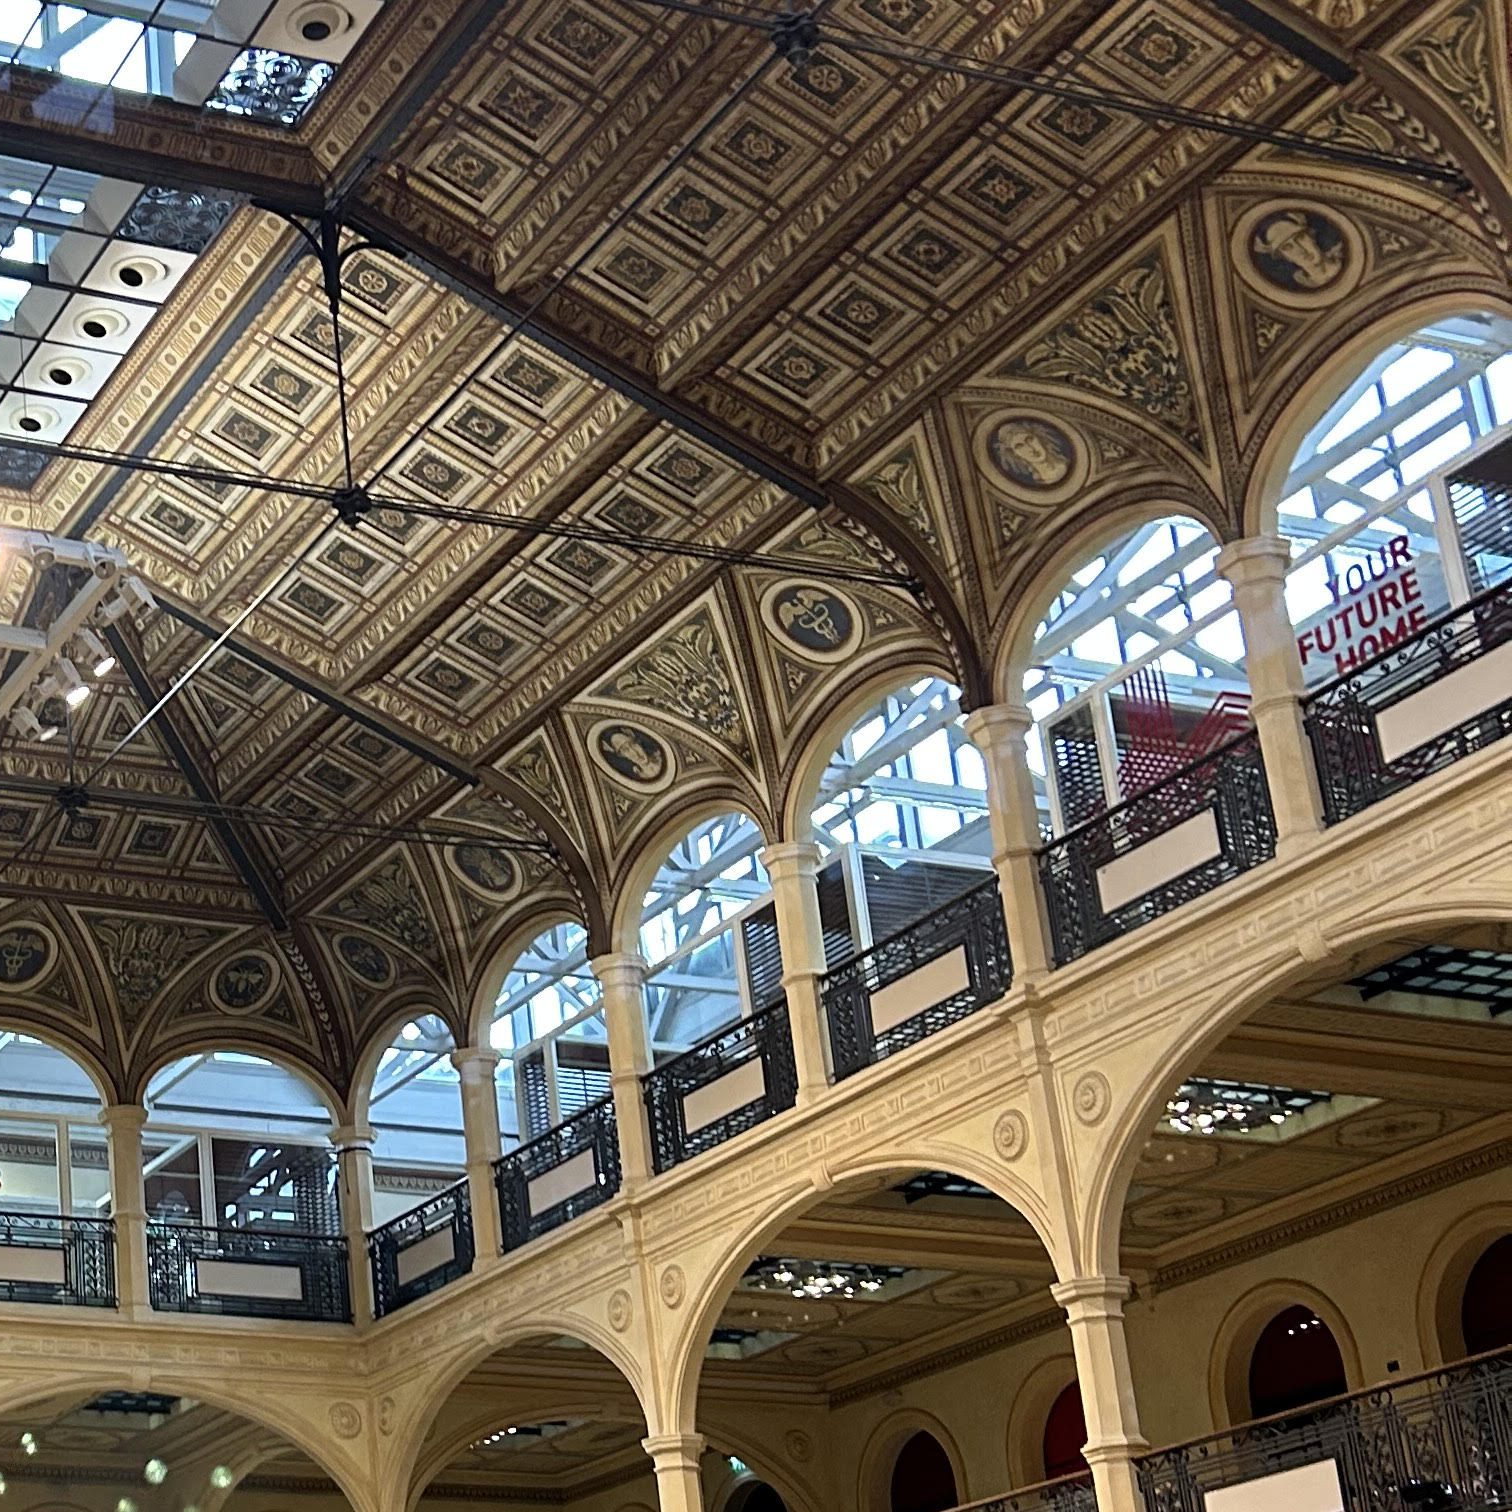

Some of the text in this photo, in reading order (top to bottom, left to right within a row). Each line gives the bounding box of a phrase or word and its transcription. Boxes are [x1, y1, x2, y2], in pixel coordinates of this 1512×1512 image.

[1326, 535, 1413, 606] YOUR
[1297, 568, 1422, 665] FUTURE
[1335, 604, 1428, 673] HOME
